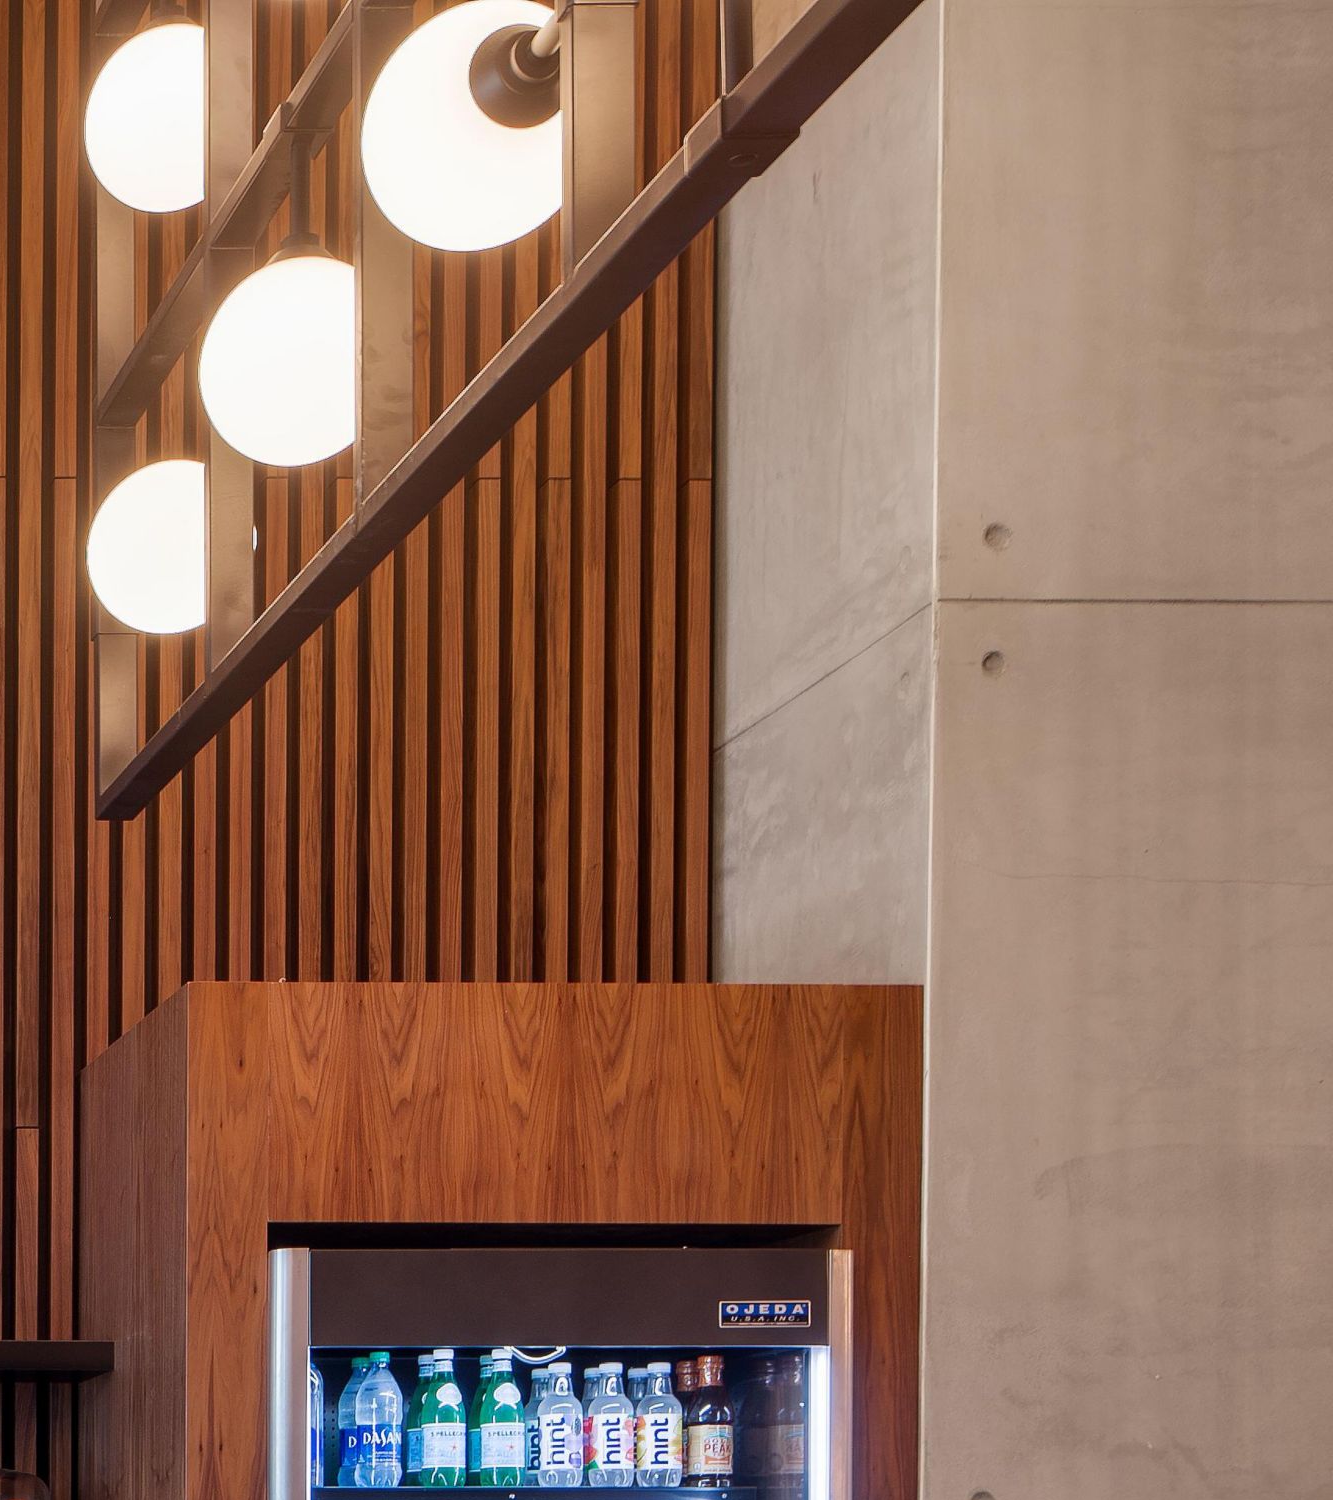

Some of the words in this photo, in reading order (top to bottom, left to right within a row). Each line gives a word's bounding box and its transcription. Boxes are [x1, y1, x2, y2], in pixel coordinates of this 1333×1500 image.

[726, 1303, 804, 1315] OJEDA
[362, 1427, 402, 1447] DASAN
[546, 1416, 565, 1465] hint
[602, 1417, 621, 1465] hint
[650, 1417, 669, 1465] hint
